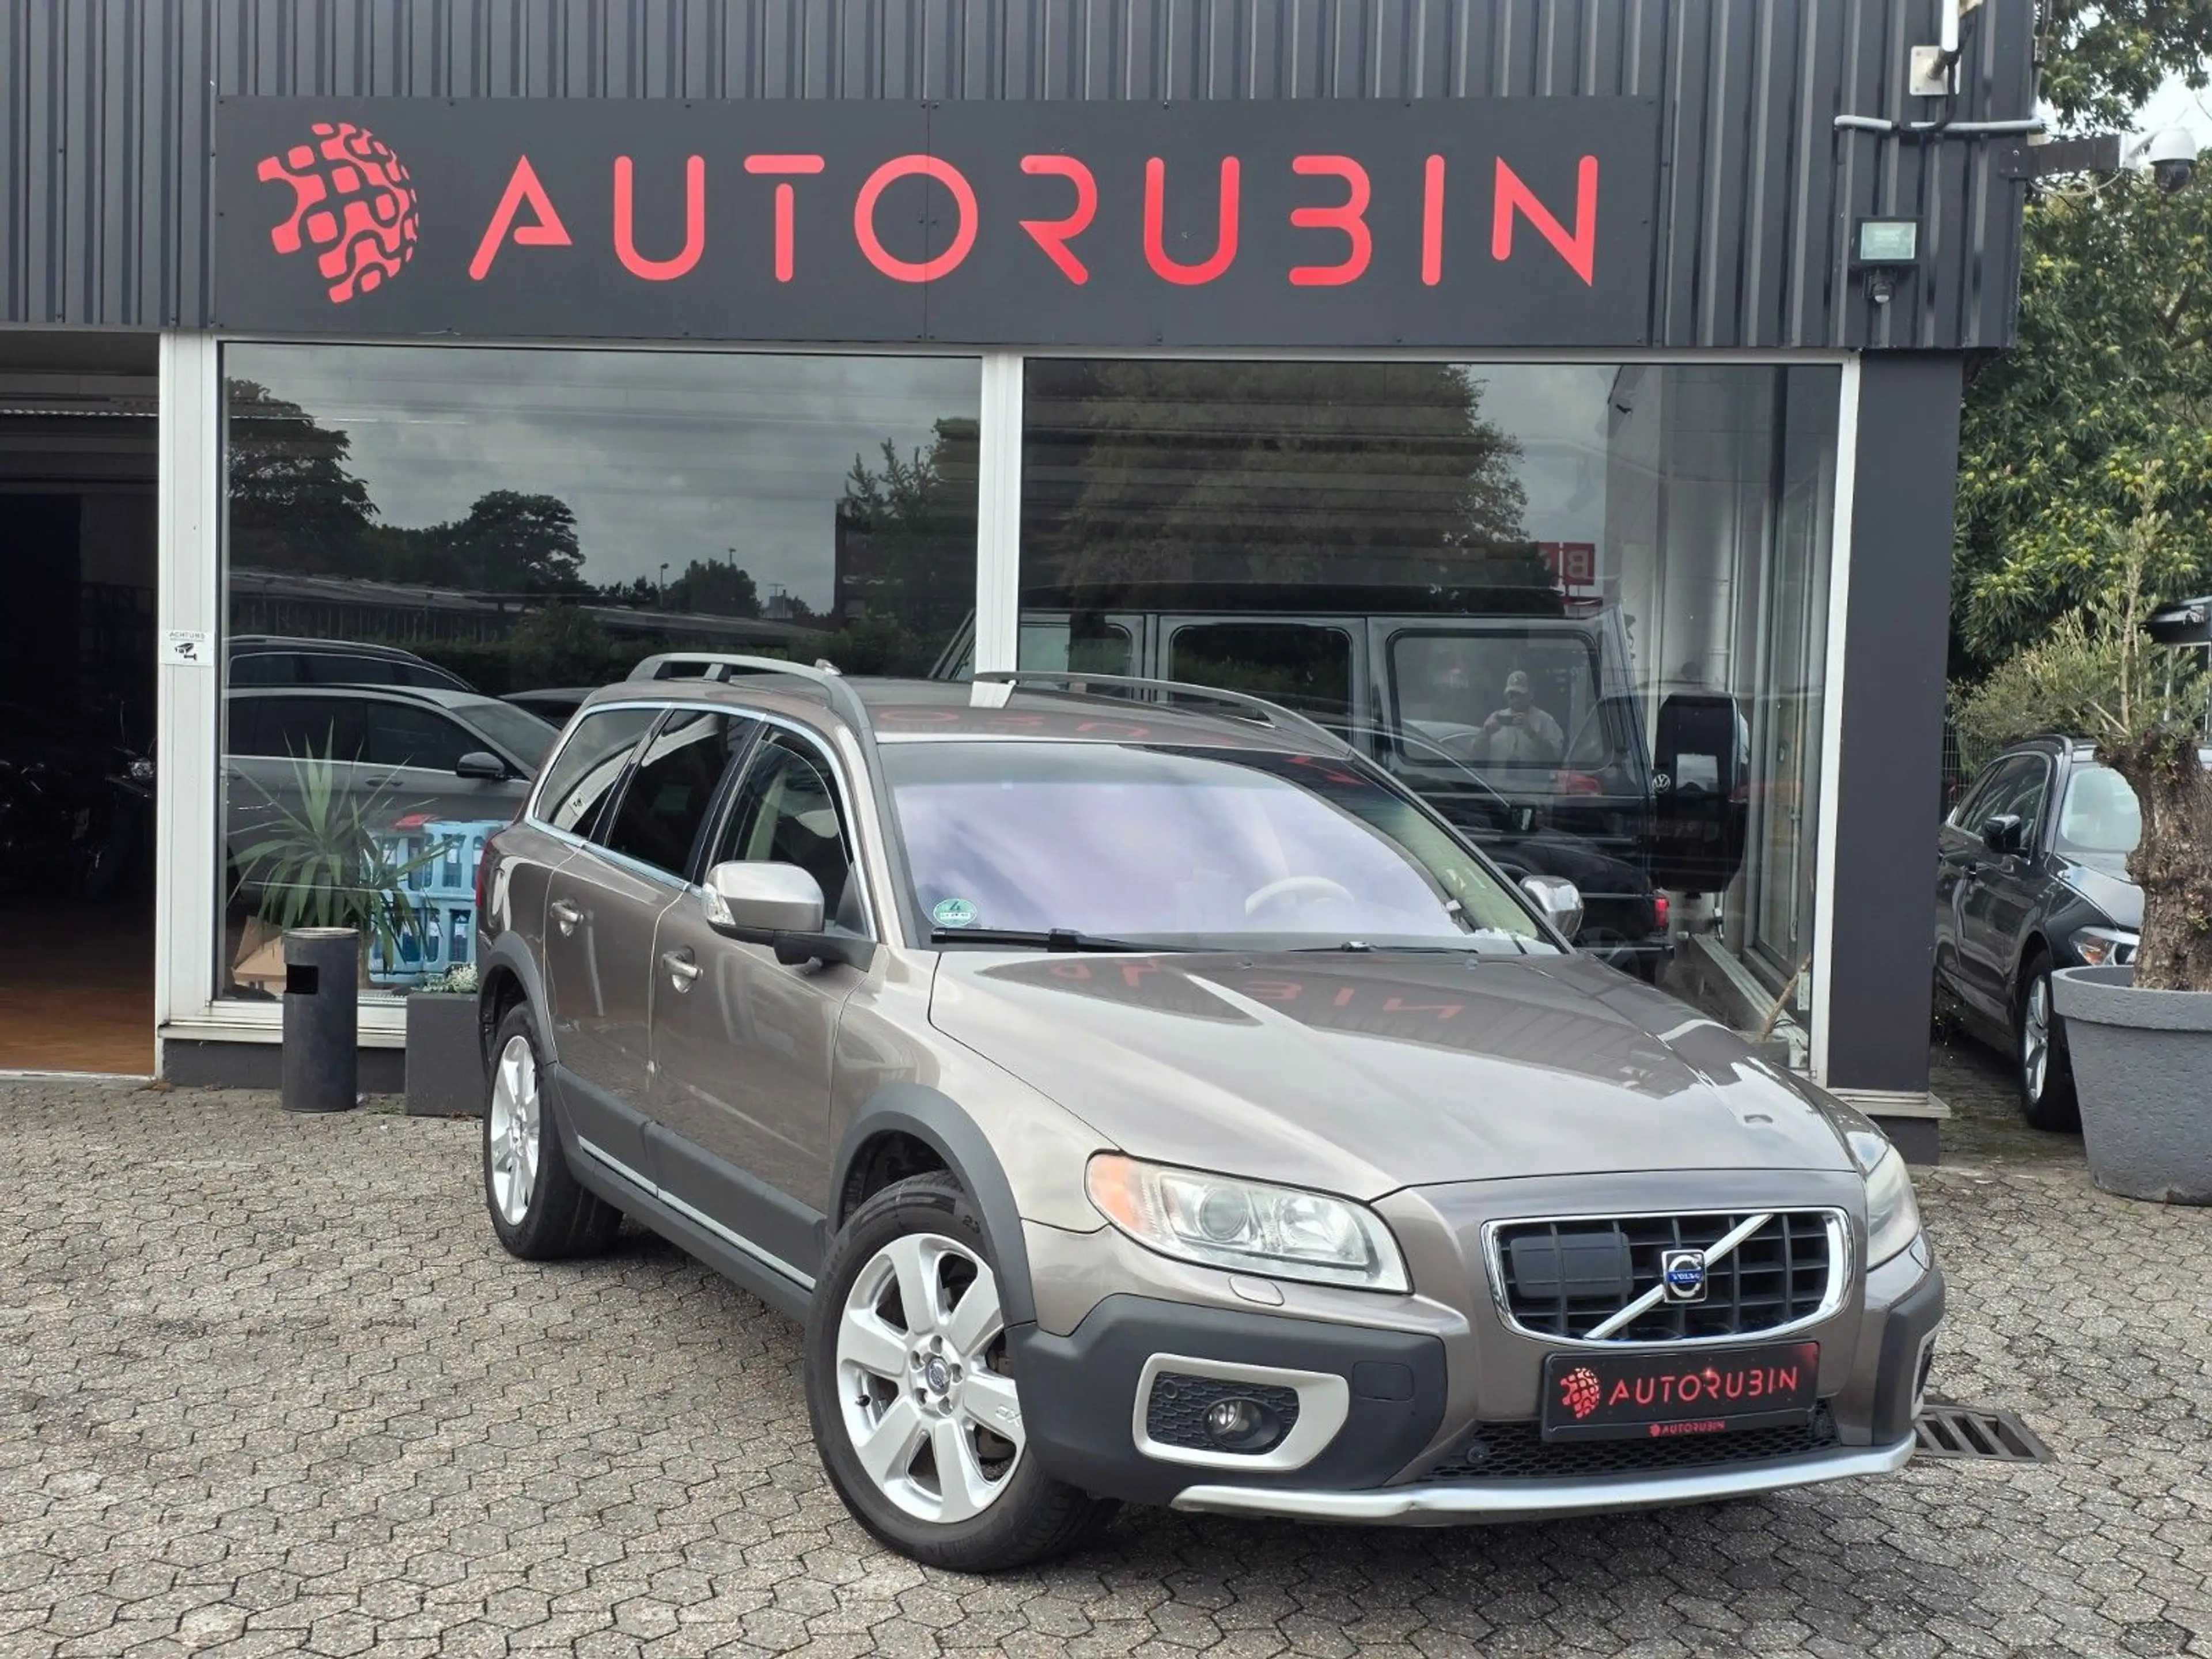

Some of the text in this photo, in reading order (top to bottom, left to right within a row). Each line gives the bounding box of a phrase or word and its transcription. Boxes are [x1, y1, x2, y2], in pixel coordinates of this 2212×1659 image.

[468, 153, 1599, 287] AUTORUBIN
[1609, 1367, 1798, 1406] AUTORUBIN
[1661, 1421, 1725, 1435] AUTORUBIN
